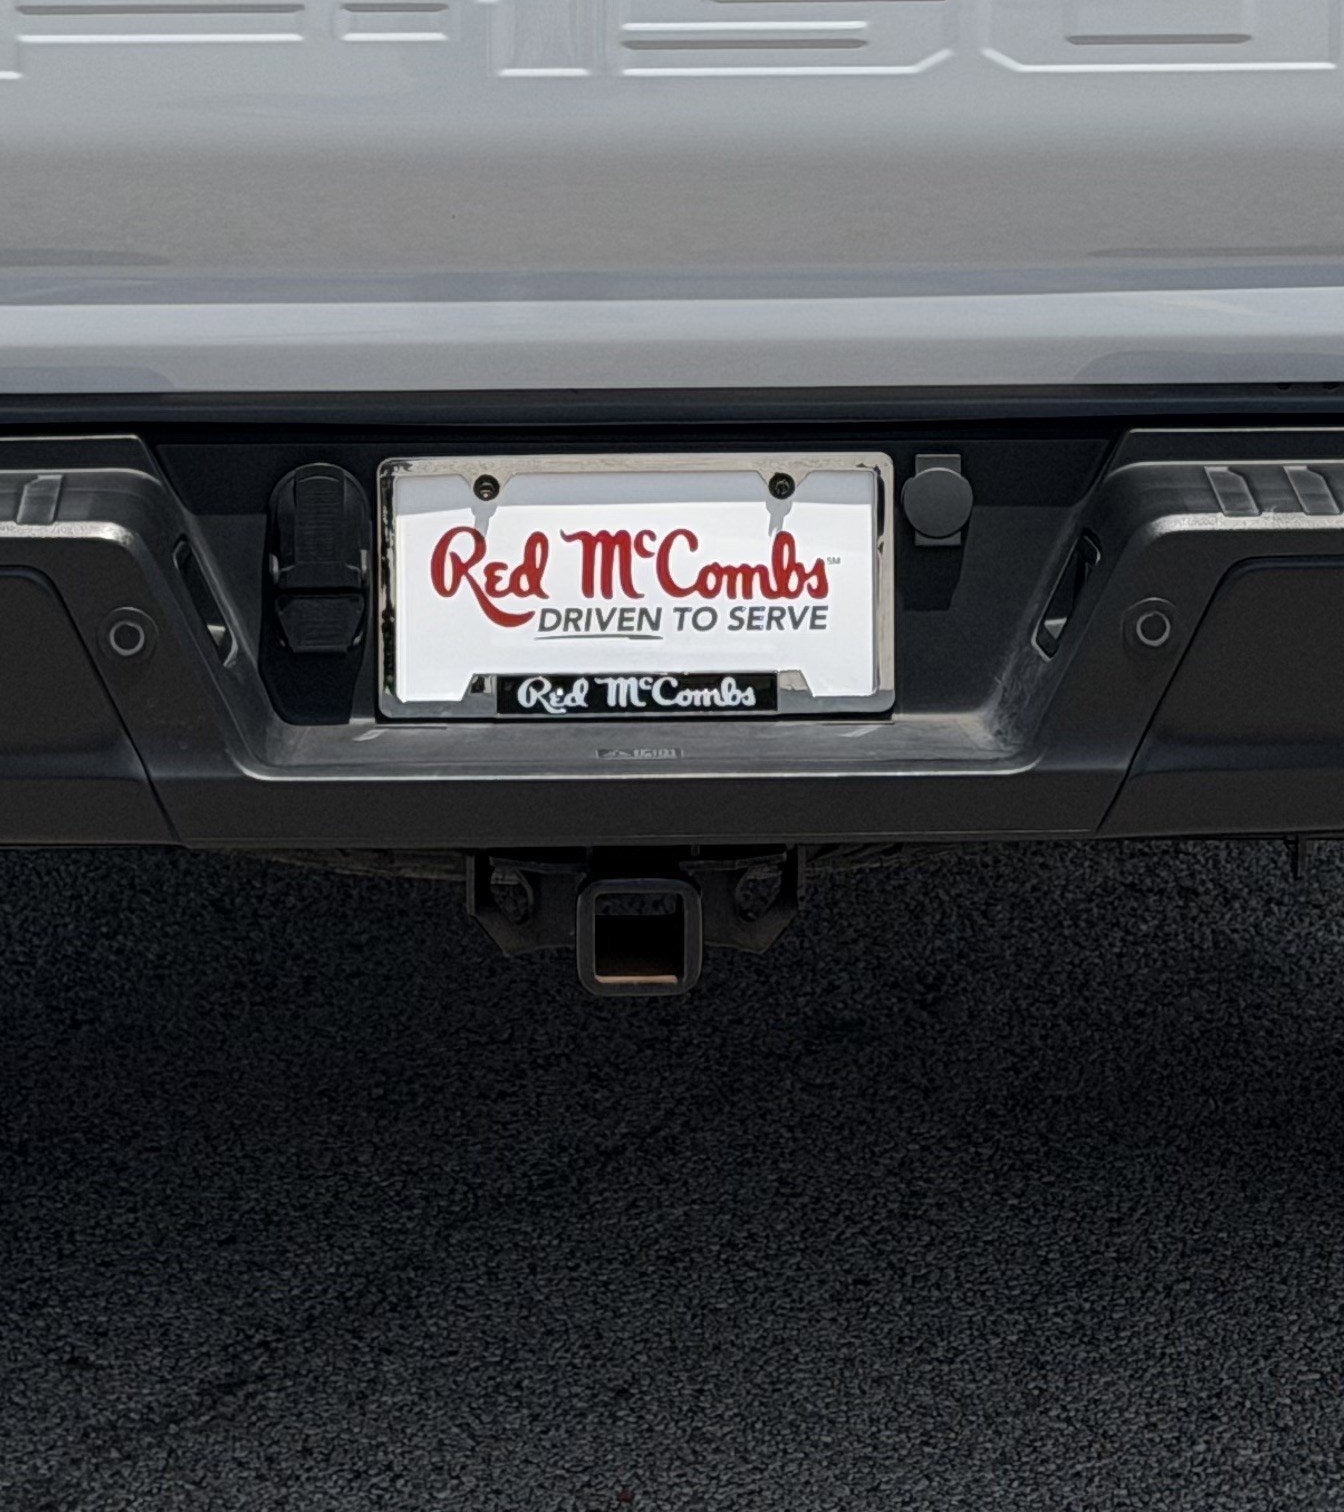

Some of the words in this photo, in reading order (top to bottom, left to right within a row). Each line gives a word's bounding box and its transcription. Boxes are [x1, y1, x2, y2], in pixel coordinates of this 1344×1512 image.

[431, 525, 549, 628] Red
[560, 528, 830, 600] McCombs
[537, 607, 662, 632] DRIVEN
[672, 607, 718, 631] TO
[727, 605, 829, 631] SERVE
[517, 674, 588, 713] Red
[594, 676, 757, 708] McCombs
